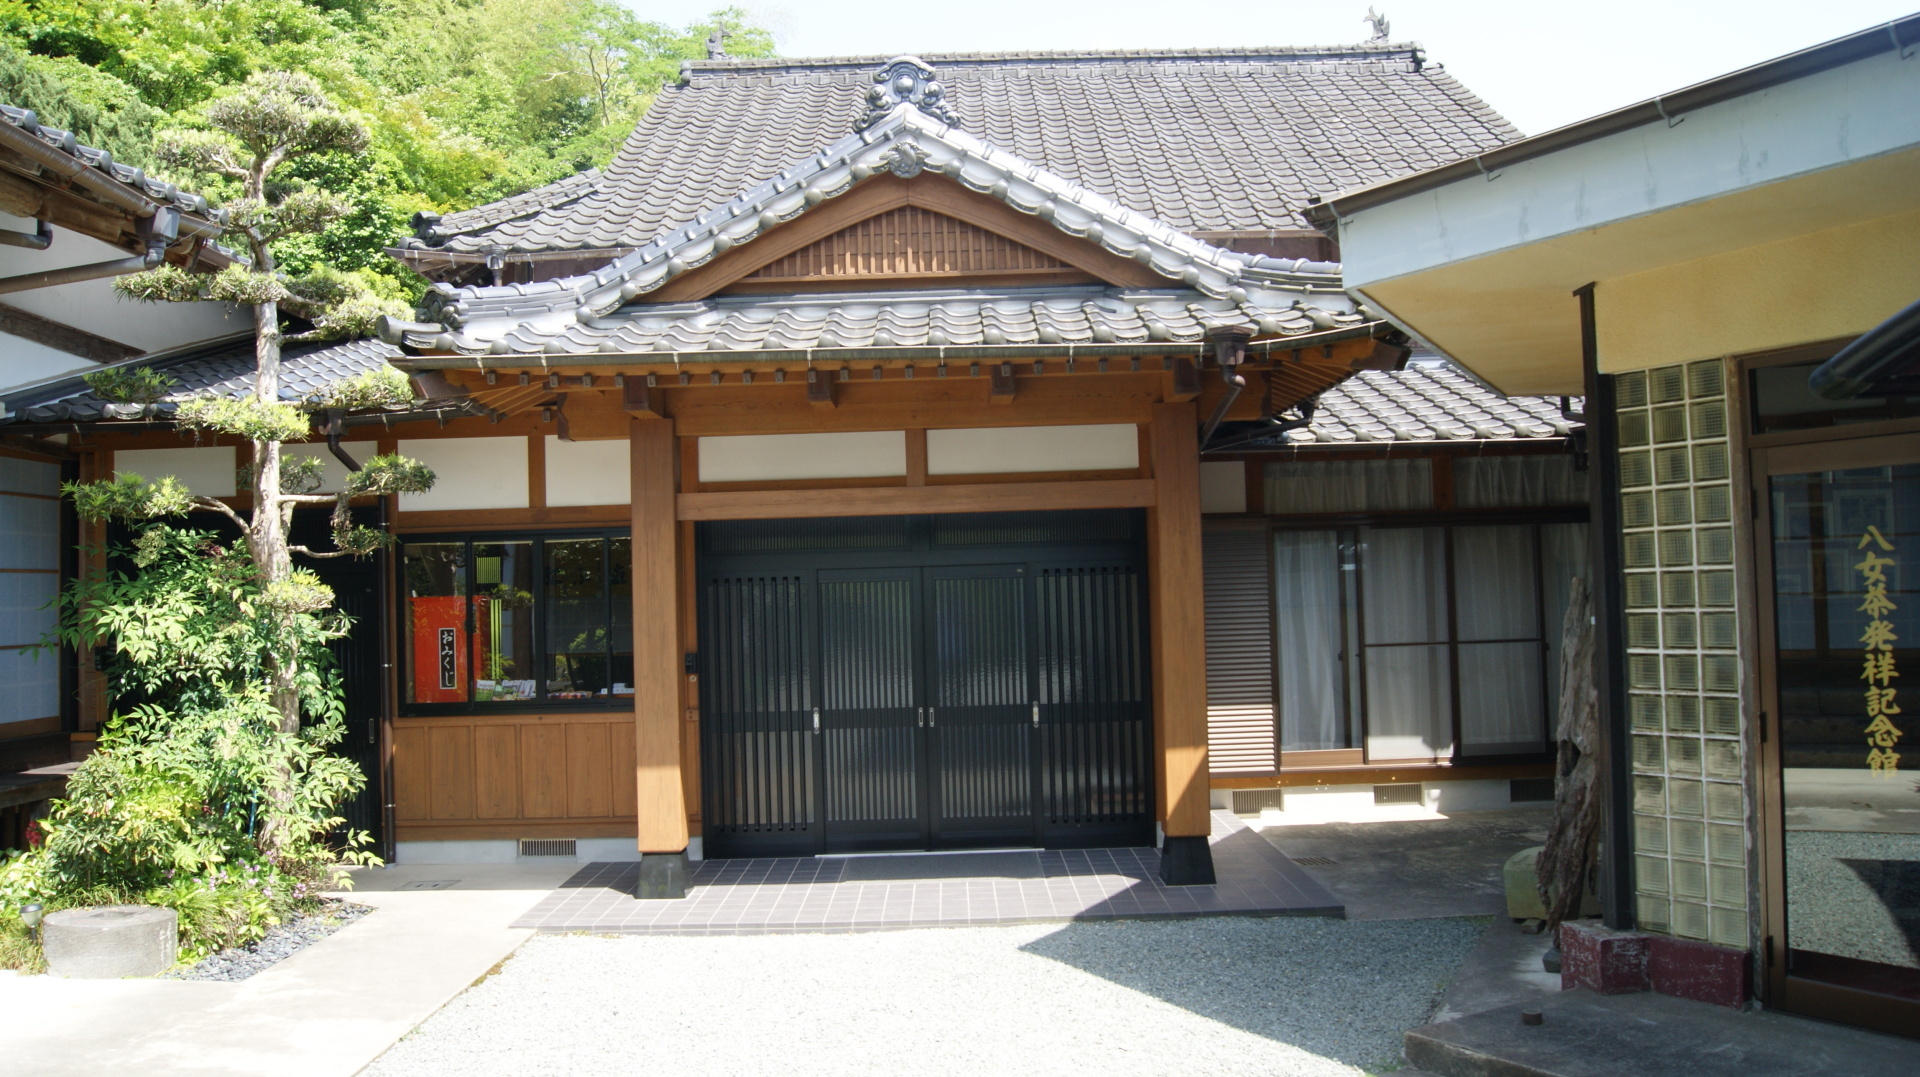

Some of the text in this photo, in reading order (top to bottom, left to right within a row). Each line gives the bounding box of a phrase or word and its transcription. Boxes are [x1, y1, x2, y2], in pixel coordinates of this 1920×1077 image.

[441, 631, 454, 686] おみくじ
[1854, 525, 1903, 780] 八女茶発祥記念館
